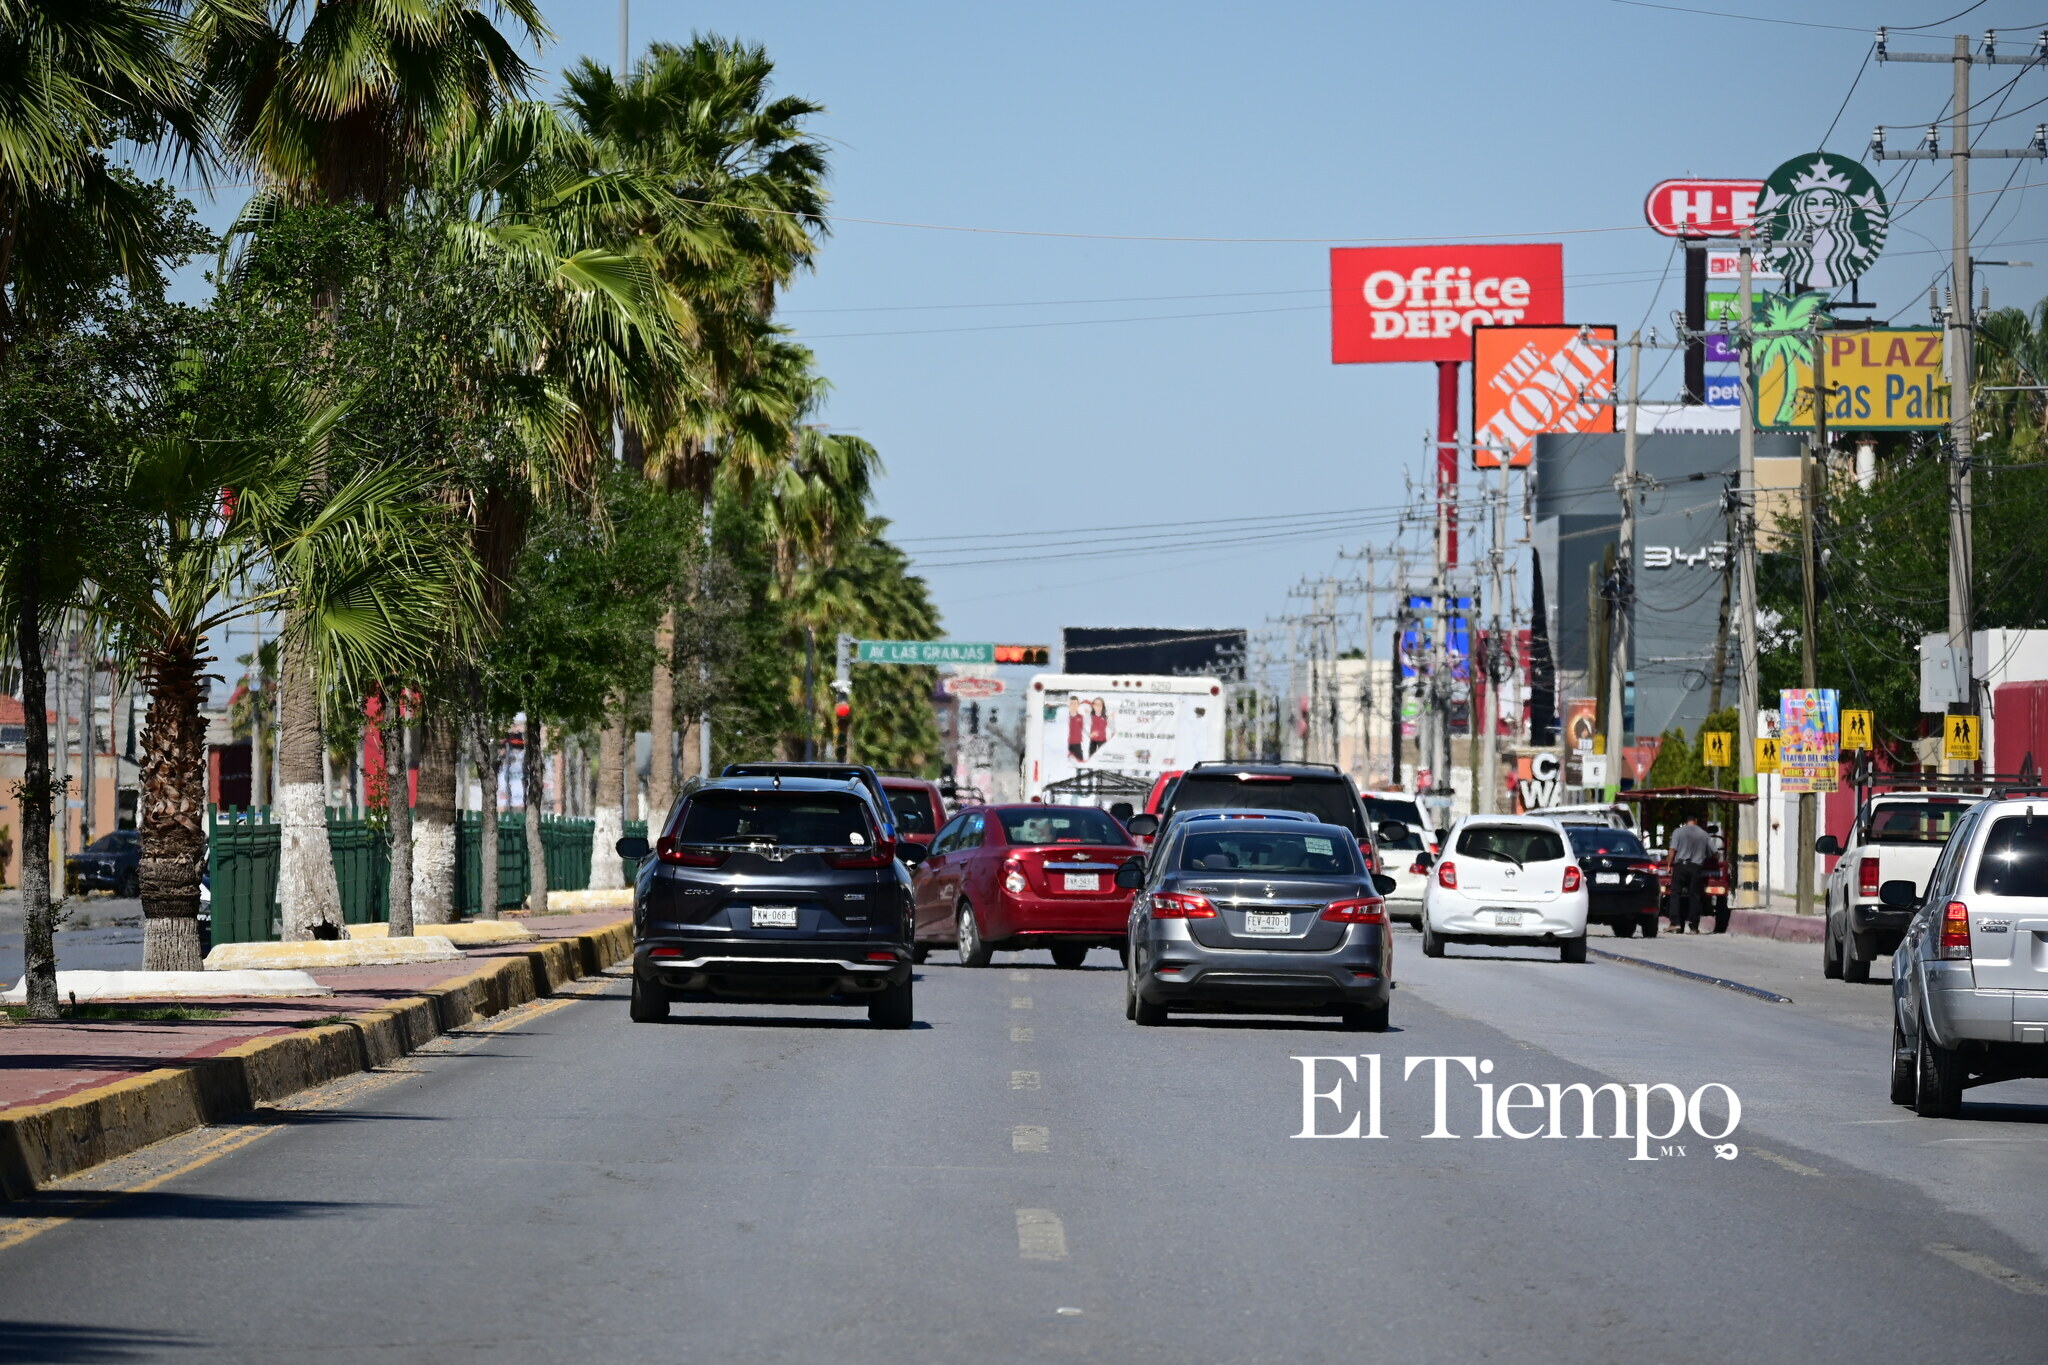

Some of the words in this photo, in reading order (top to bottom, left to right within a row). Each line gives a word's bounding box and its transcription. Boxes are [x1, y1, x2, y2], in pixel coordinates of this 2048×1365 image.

[1363, 266, 1531, 309] Office
[1489, 341, 1548, 395] THE
[1825, 384, 1872, 419] as
[891, 646, 919, 660] LAS
[922, 646, 986, 661] GRANJAS
[1804, 768, 1816, 777] 27
